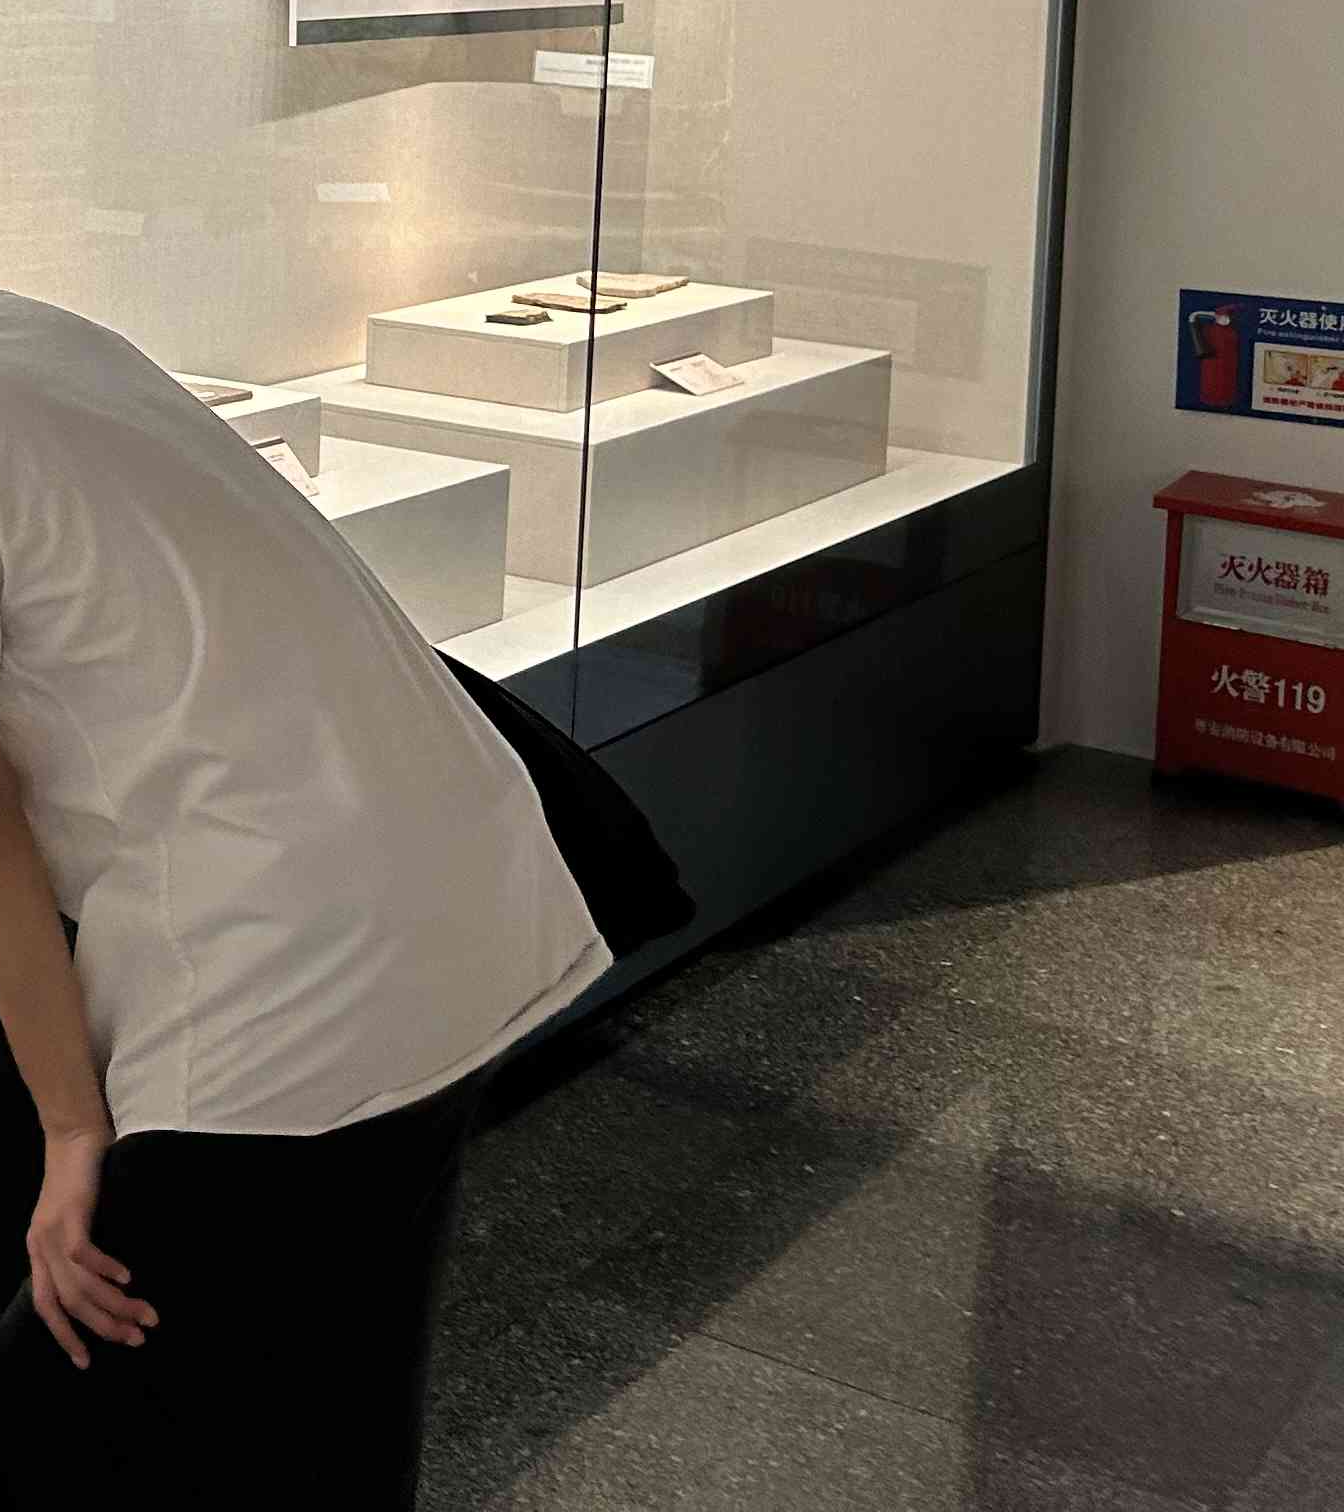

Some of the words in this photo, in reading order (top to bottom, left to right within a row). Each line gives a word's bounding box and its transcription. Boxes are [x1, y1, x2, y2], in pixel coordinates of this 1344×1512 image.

[1216, 553, 1330, 596] 灭火器箱
[1210, 664, 1326, 714] 火警119
